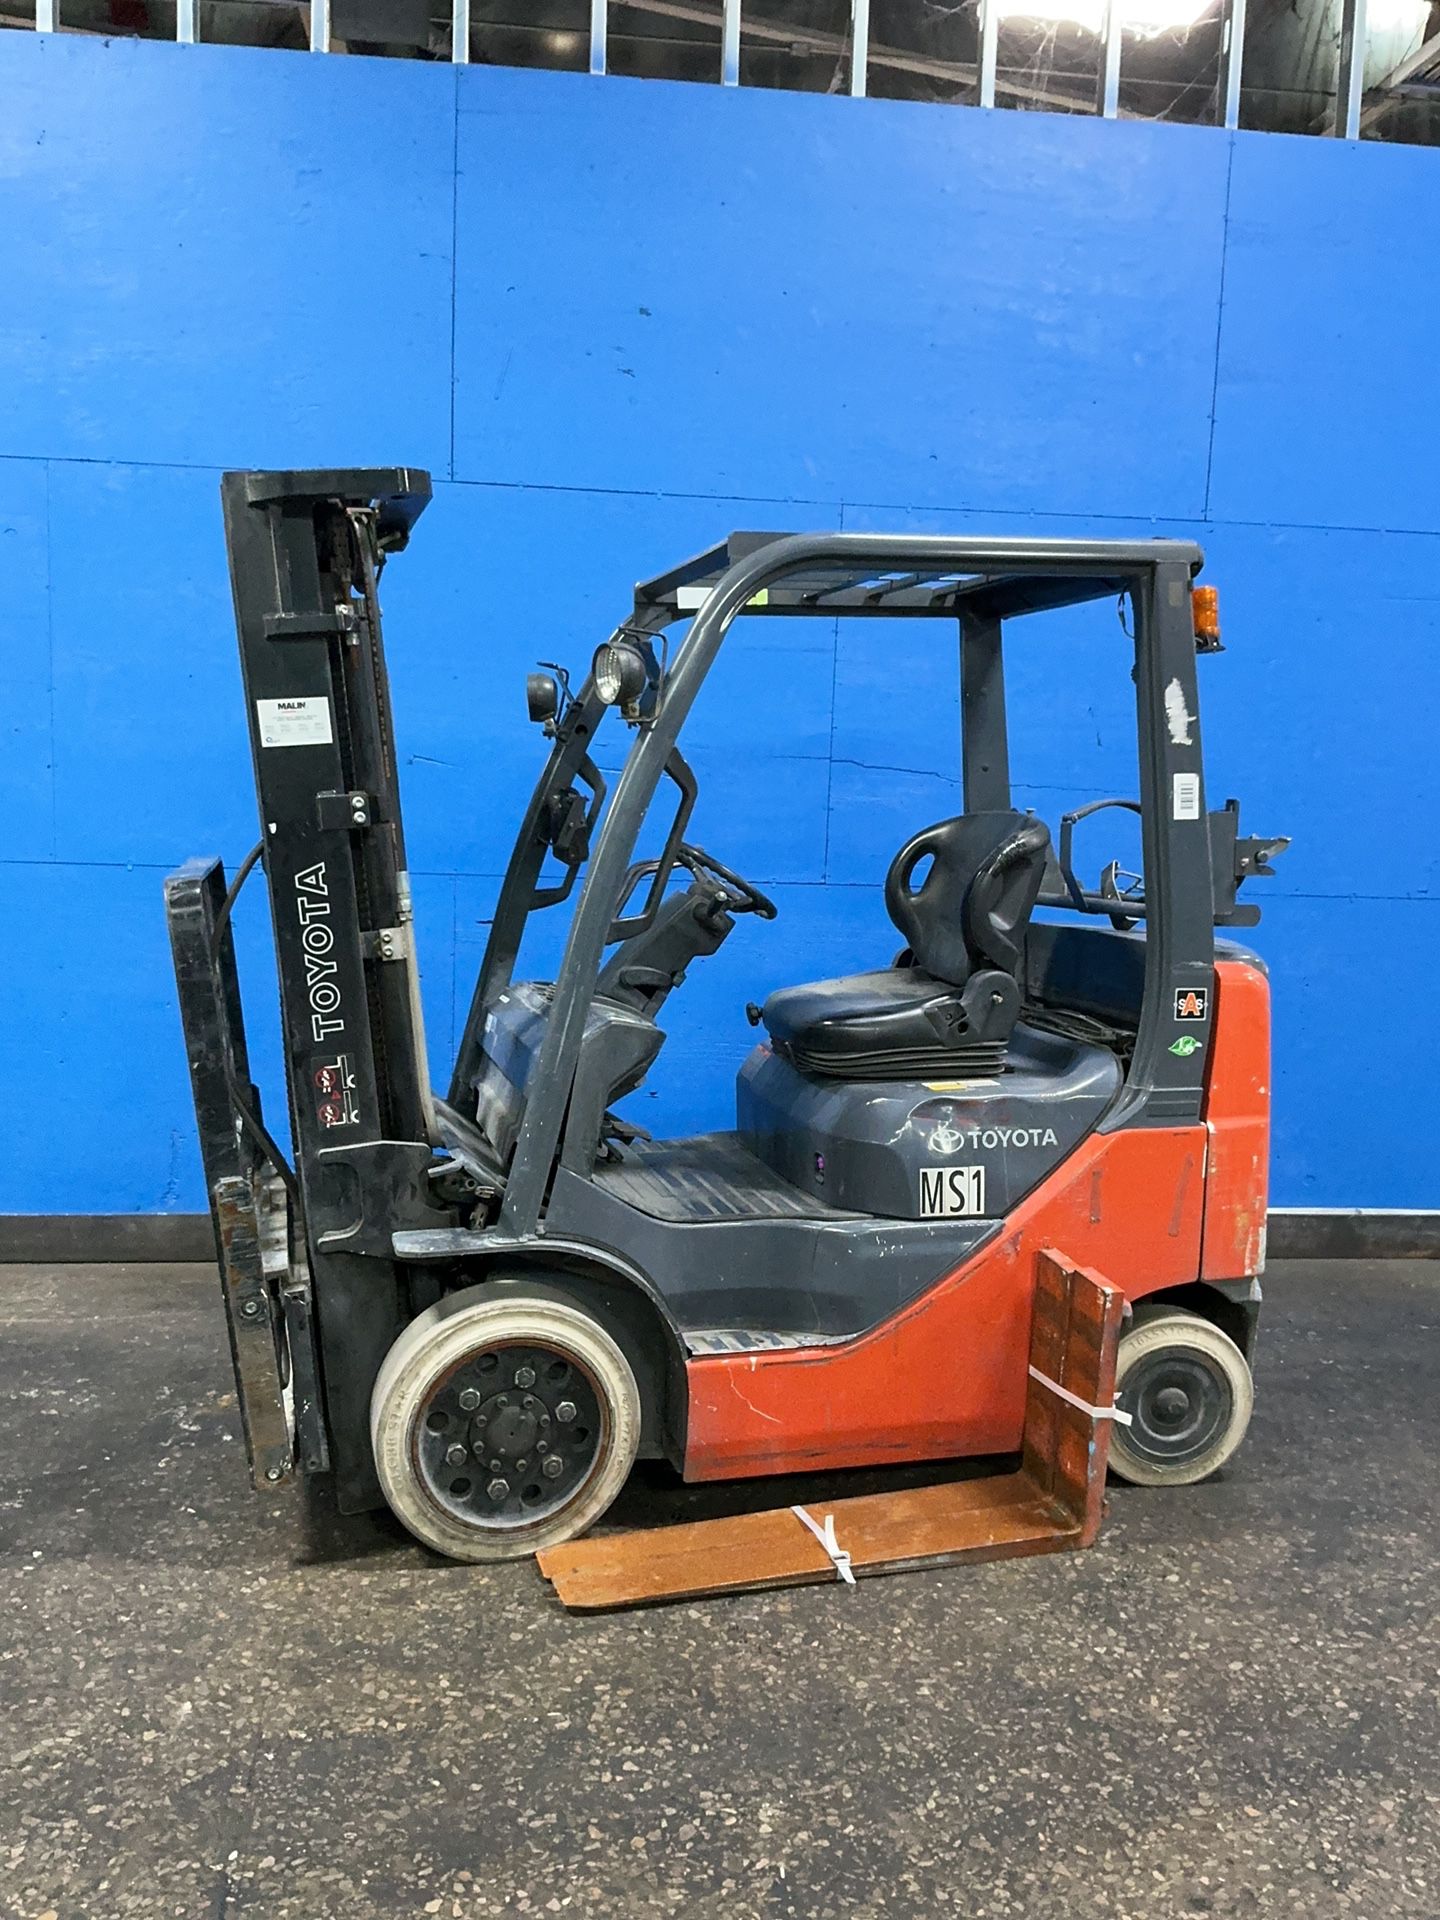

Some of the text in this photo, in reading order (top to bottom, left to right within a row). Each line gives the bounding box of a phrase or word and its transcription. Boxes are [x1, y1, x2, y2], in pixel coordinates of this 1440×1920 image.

[277, 701, 306, 710] MALIN
[294, 861, 345, 1042] TOYOTA
[1178, 992, 1204, 1016] SAS
[967, 1128, 1059, 1149] TOYOTA
[921, 1169, 982, 1214] MS1
